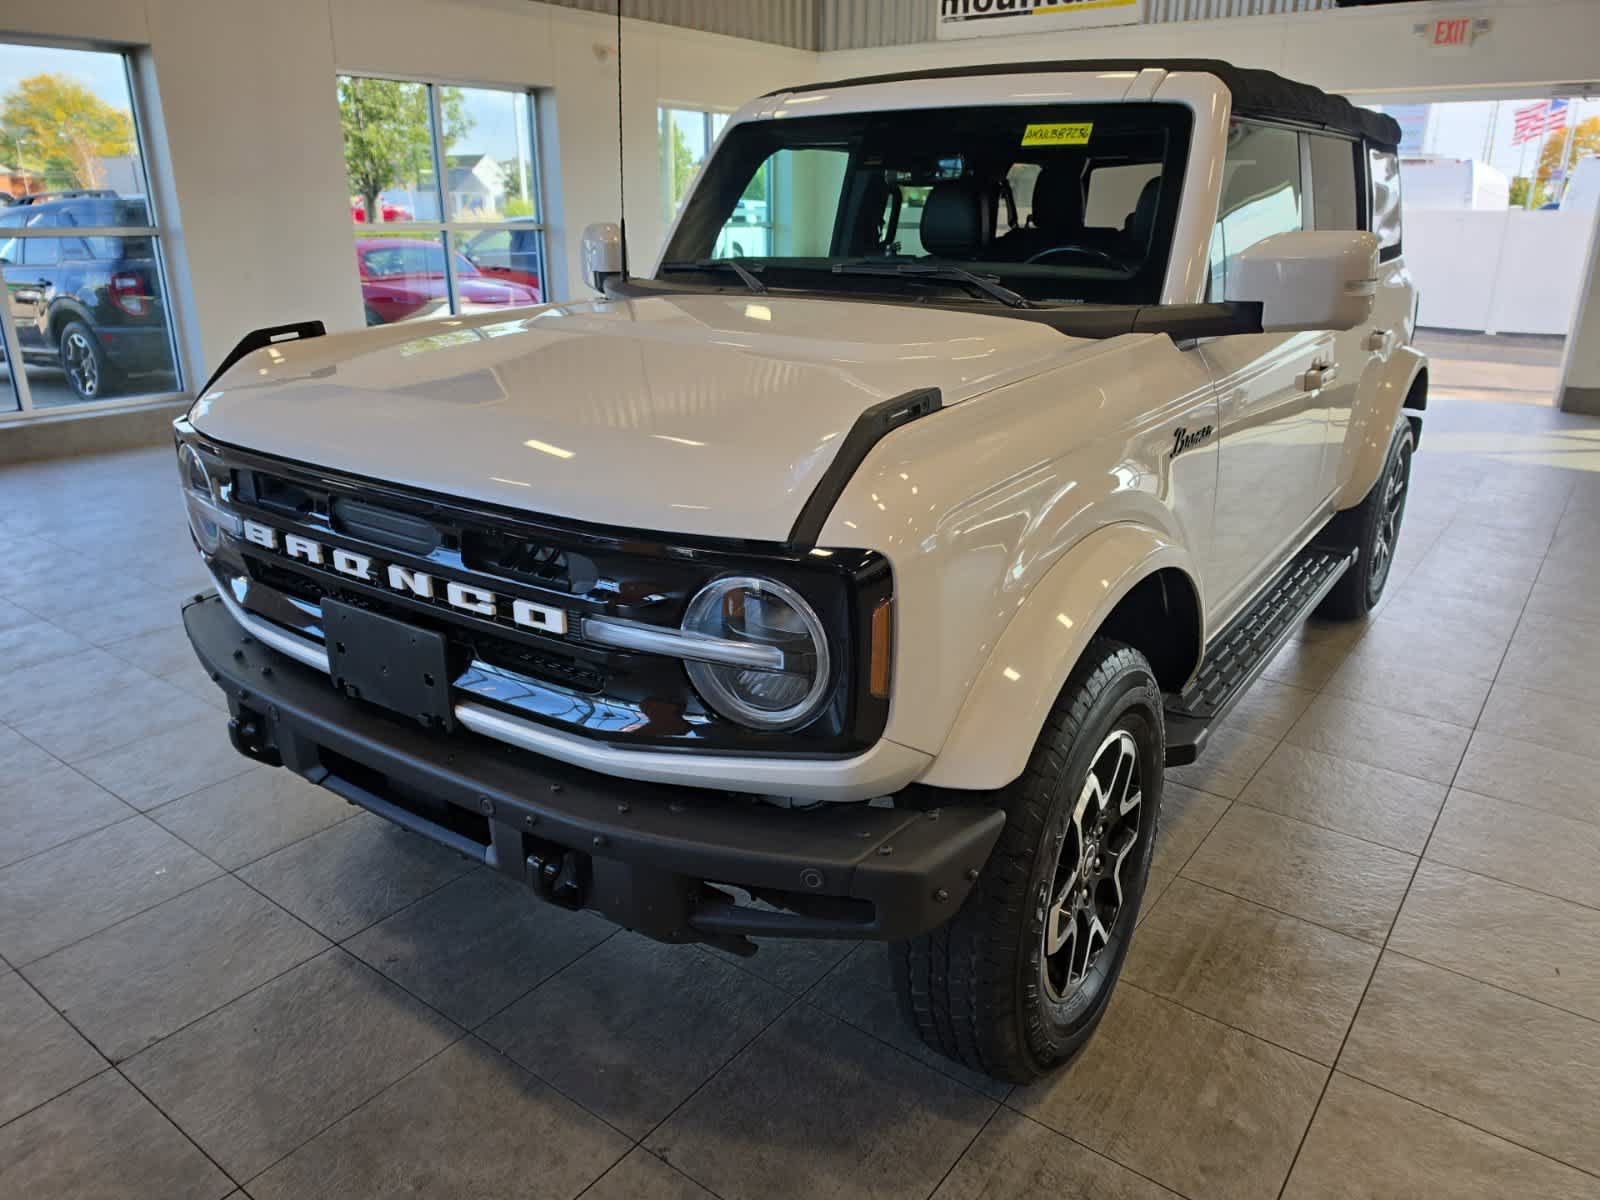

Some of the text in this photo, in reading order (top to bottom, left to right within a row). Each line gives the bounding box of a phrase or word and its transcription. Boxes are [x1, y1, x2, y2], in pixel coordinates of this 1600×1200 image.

[1434, 19, 1470, 45] EXIT
[1170, 425, 1214, 458] Bronco
[243, 519, 568, 635] BRONCO
